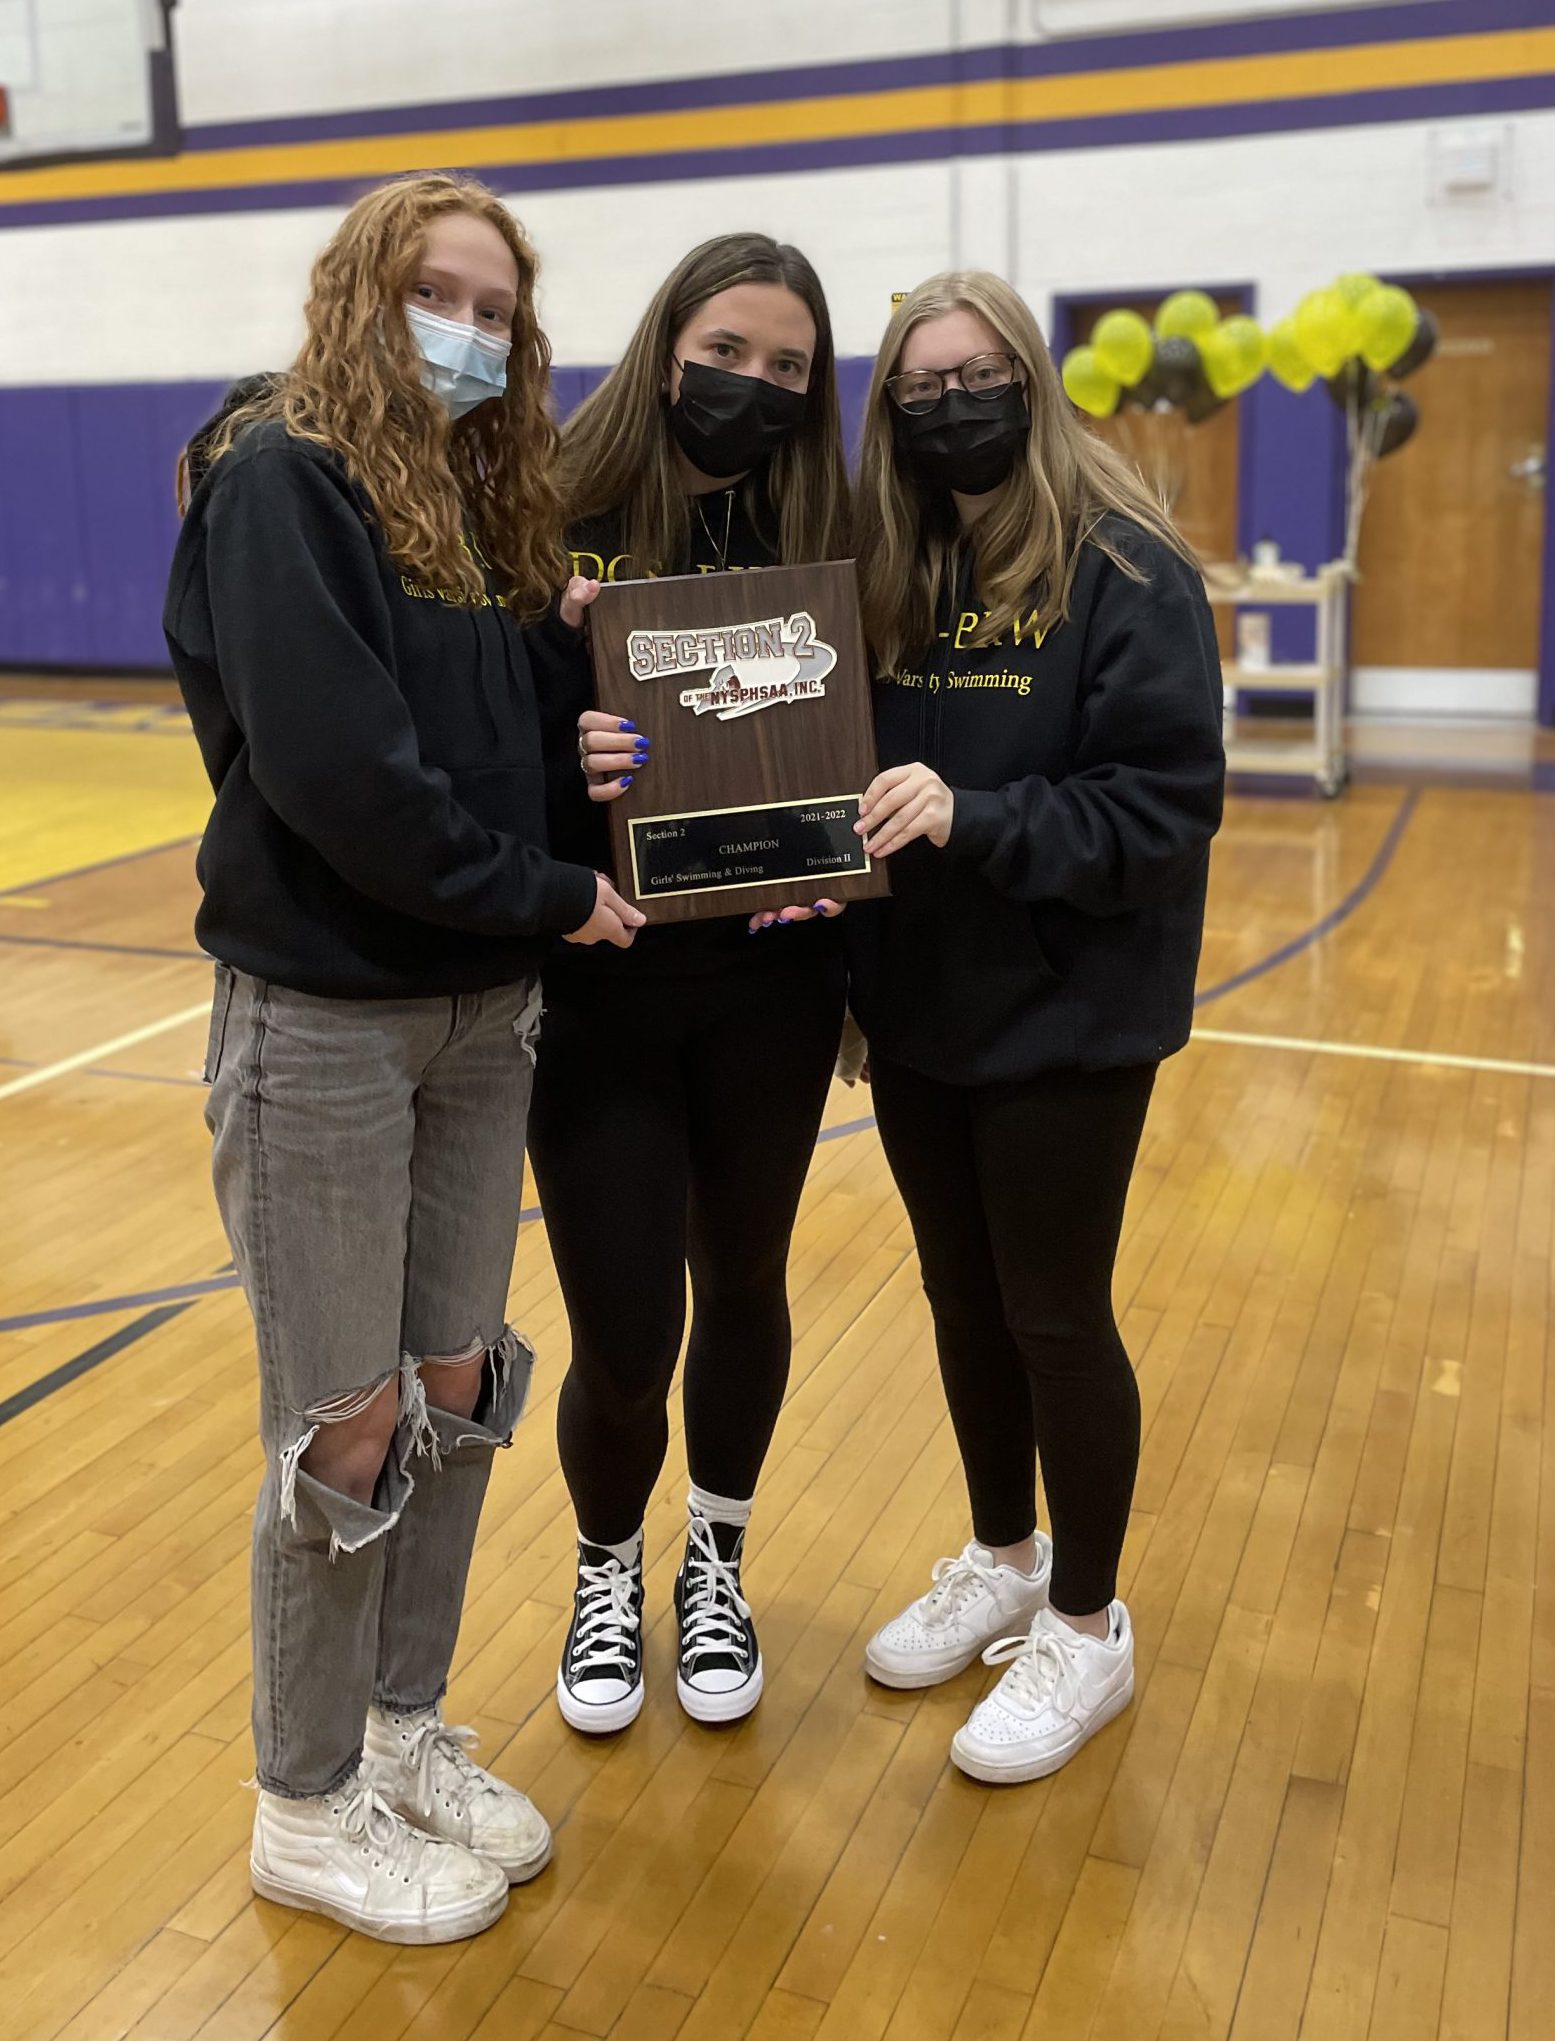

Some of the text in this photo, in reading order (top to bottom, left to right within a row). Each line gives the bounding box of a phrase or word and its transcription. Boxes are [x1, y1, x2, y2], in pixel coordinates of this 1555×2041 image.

[631, 616, 815, 677] SECTION 2
[683, 694, 694, 703] OF
[695, 692, 711, 702] THE
[794, 680, 822, 695] INC.
[946, 669, 1033, 696] Swimming
[800, 809, 846, 823] 2021-2022
[646, 828, 686, 841] Section 2
[718, 839, 780, 855] CHAMPION
[806, 853, 851, 867] Division II
[650, 865, 764, 886] Girls' Swimming & Diving
